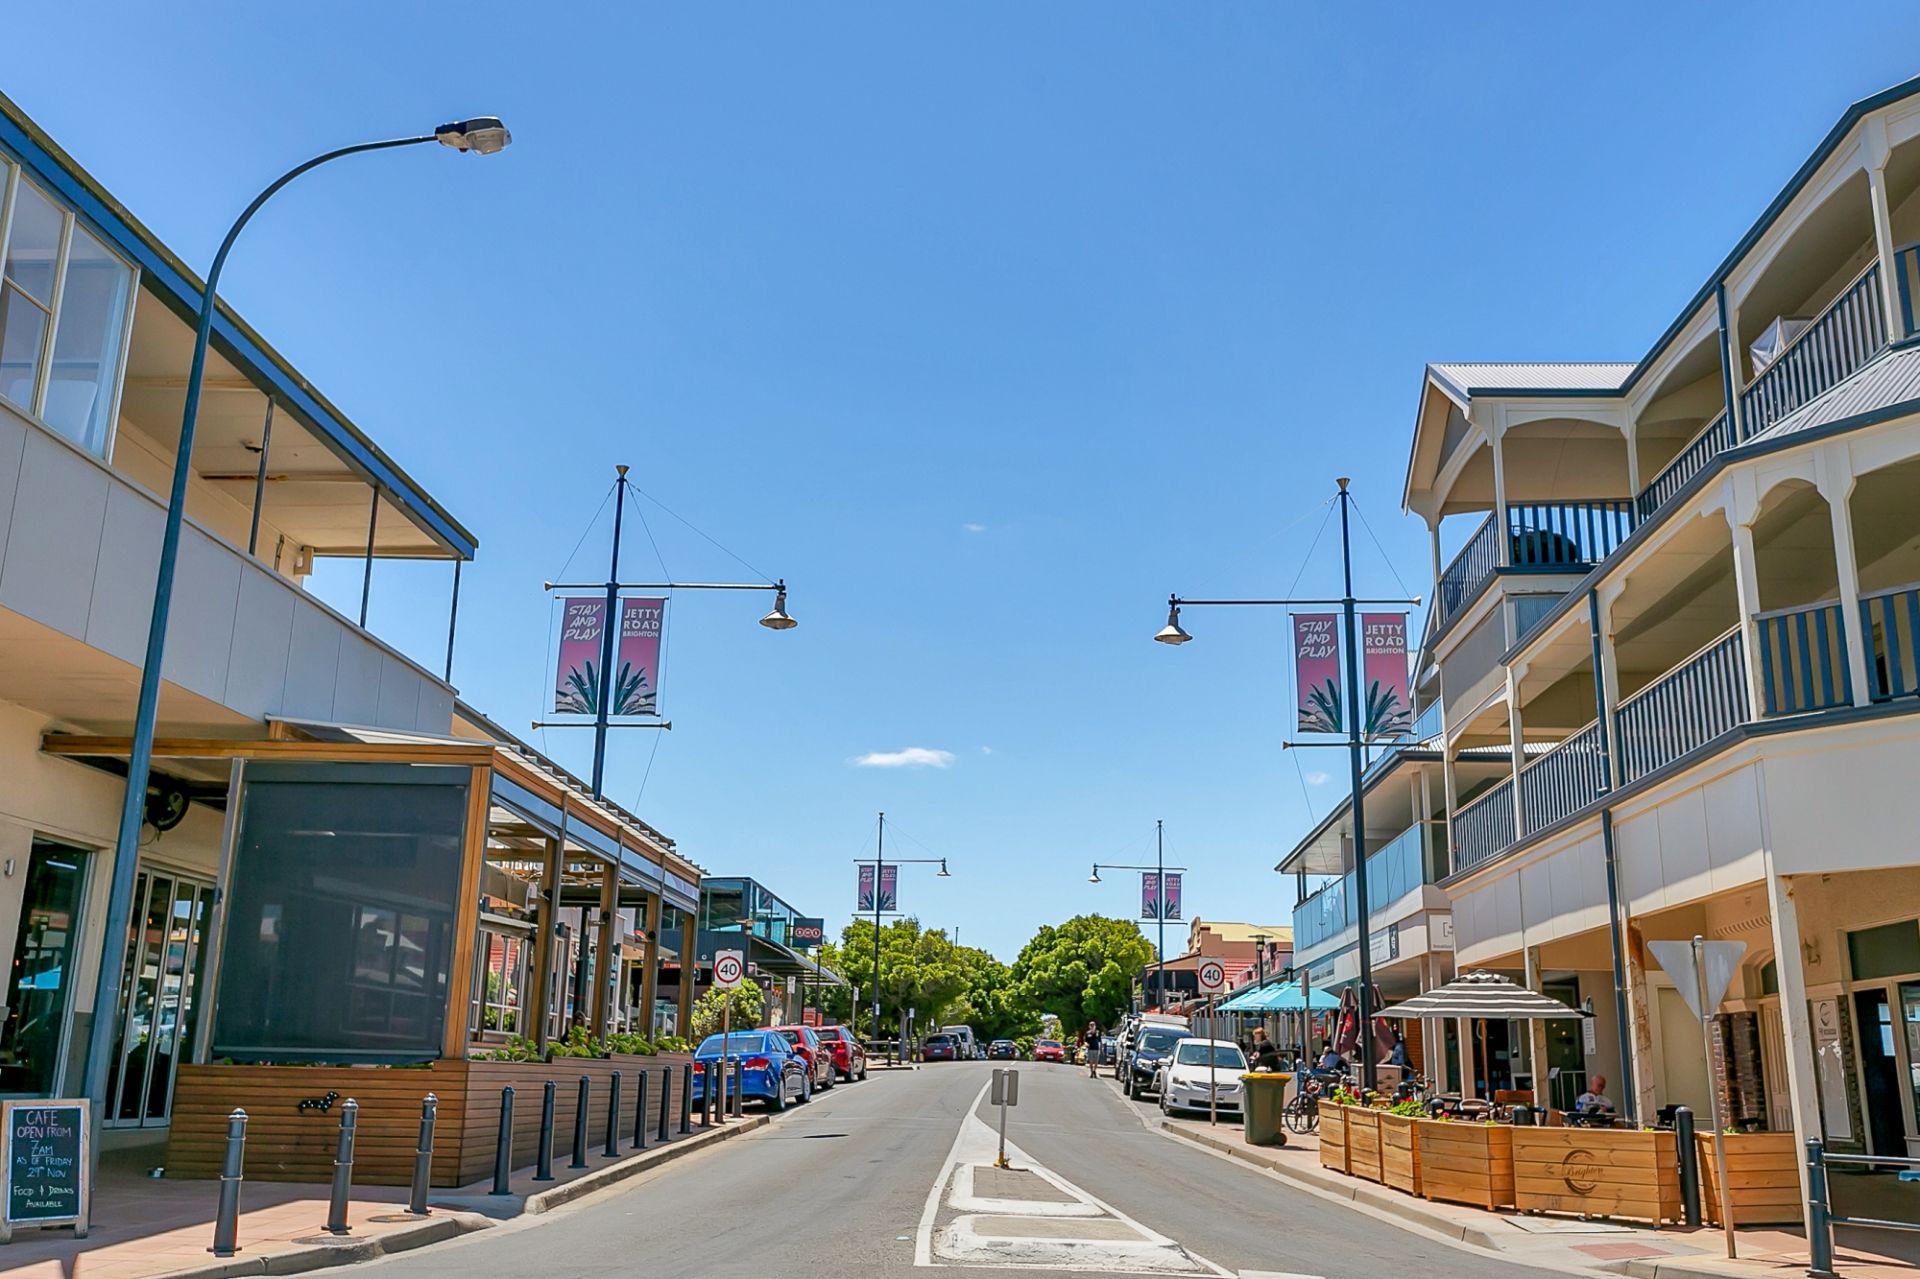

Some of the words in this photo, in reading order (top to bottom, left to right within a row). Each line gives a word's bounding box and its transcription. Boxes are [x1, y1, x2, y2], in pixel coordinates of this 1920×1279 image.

[569, 604, 601, 616] STAY
[624, 608, 661, 619] JETTY
[569, 616, 597, 628] AND
[623, 620, 660, 630] ROAD
[1299, 620, 1332, 632] STAY
[563, 628, 601, 641] PLAY
[622, 630, 659, 638] BRIGHTON
[1365, 624, 1403, 635] JETTY
[1303, 633, 1330, 645] AND
[1365, 637, 1404, 646] ROAD
[1298, 645, 1336, 658] PLAY
[1366, 647, 1404, 655] BRIGHTON
[720, 963, 738, 976] 40
[1204, 969, 1220, 981] 40
[26, 1110, 58, 1126] CAFE
[17, 1126, 43, 1138] OPEN
[47, 1127, 71, 1137] FROM
[16, 1156, 27, 1165] AS
[31, 1157, 40, 1165] OF
[45, 1156, 73, 1166] FRIDAY
